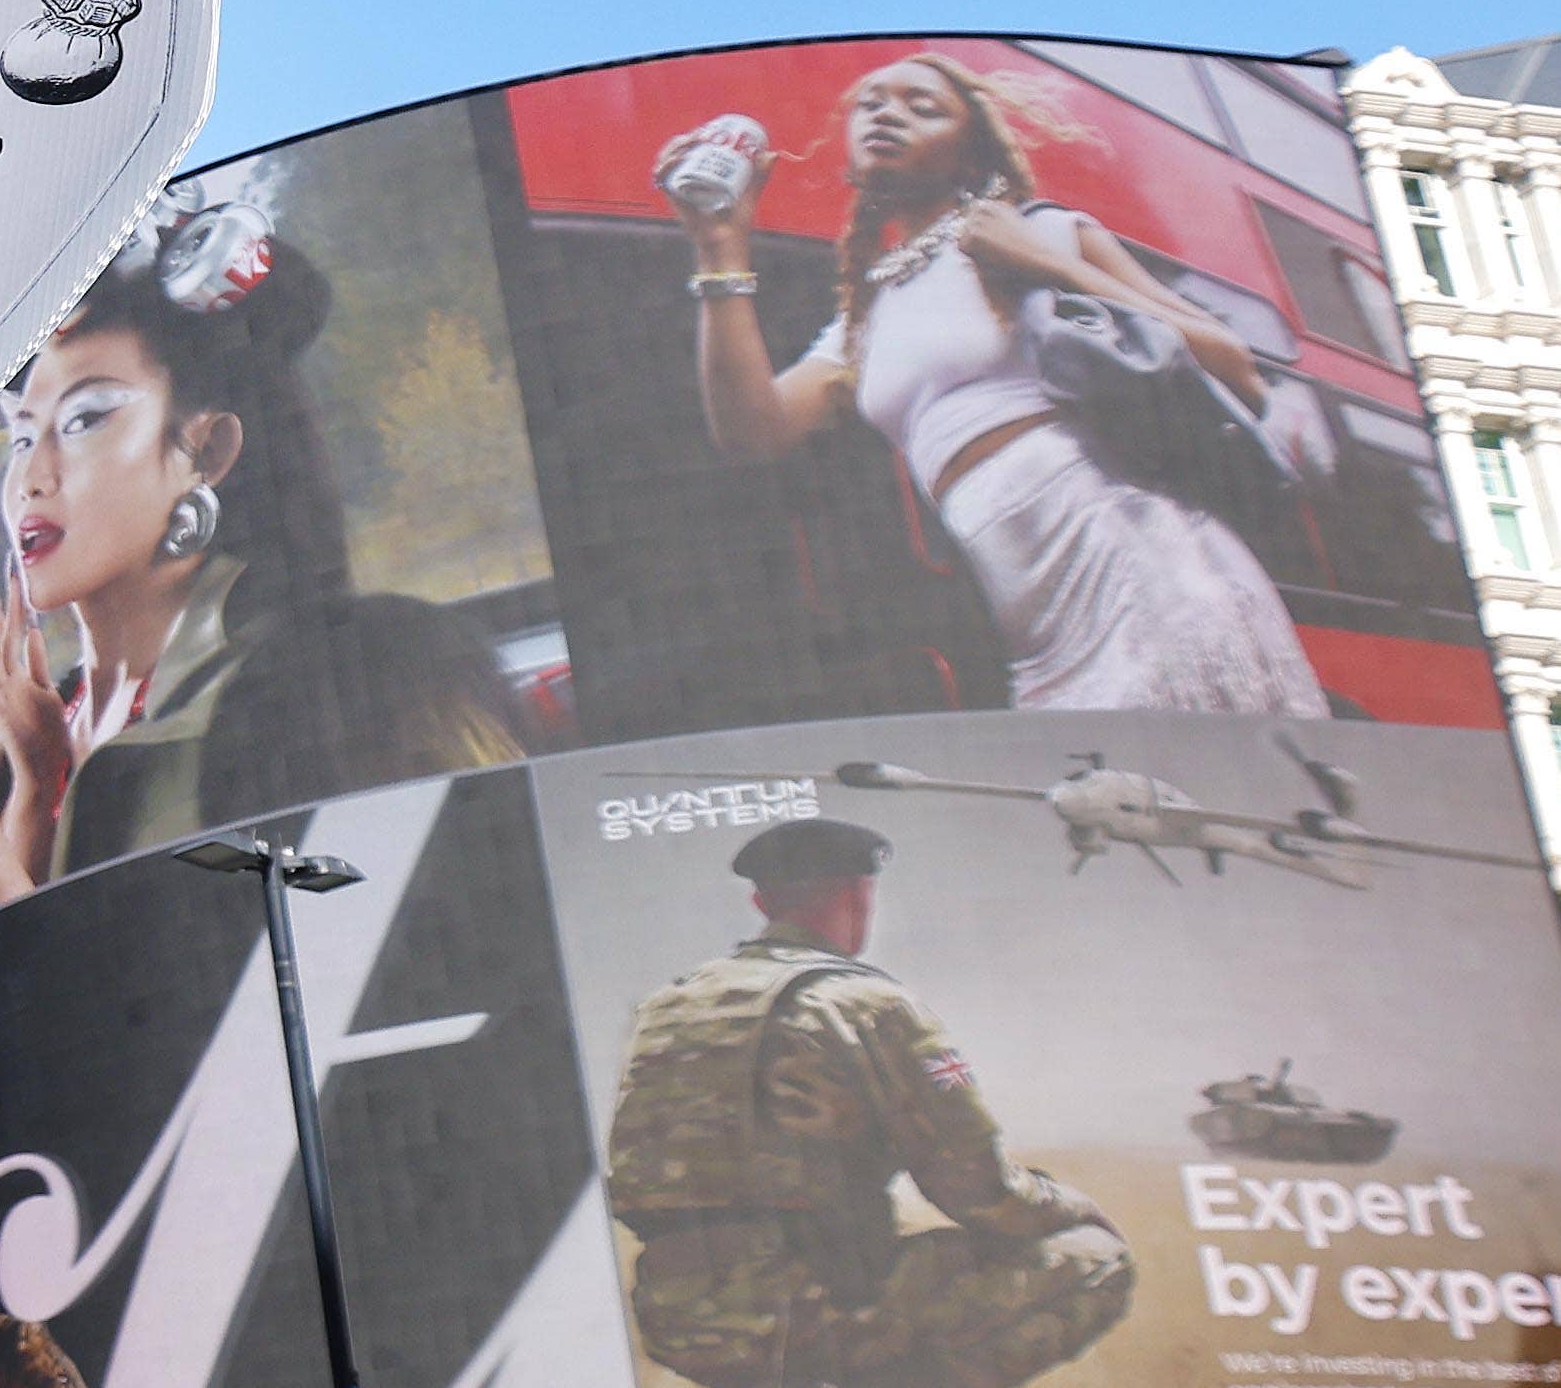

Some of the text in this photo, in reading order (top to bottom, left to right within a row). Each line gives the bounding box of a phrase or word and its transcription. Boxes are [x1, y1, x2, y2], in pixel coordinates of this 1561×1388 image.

[597, 777, 817, 821] QUANTUM
[600, 797, 820, 841] SYSTEMS
[1181, 1163, 1485, 1250] Expert
[1197, 1243, 1318, 1335] by
